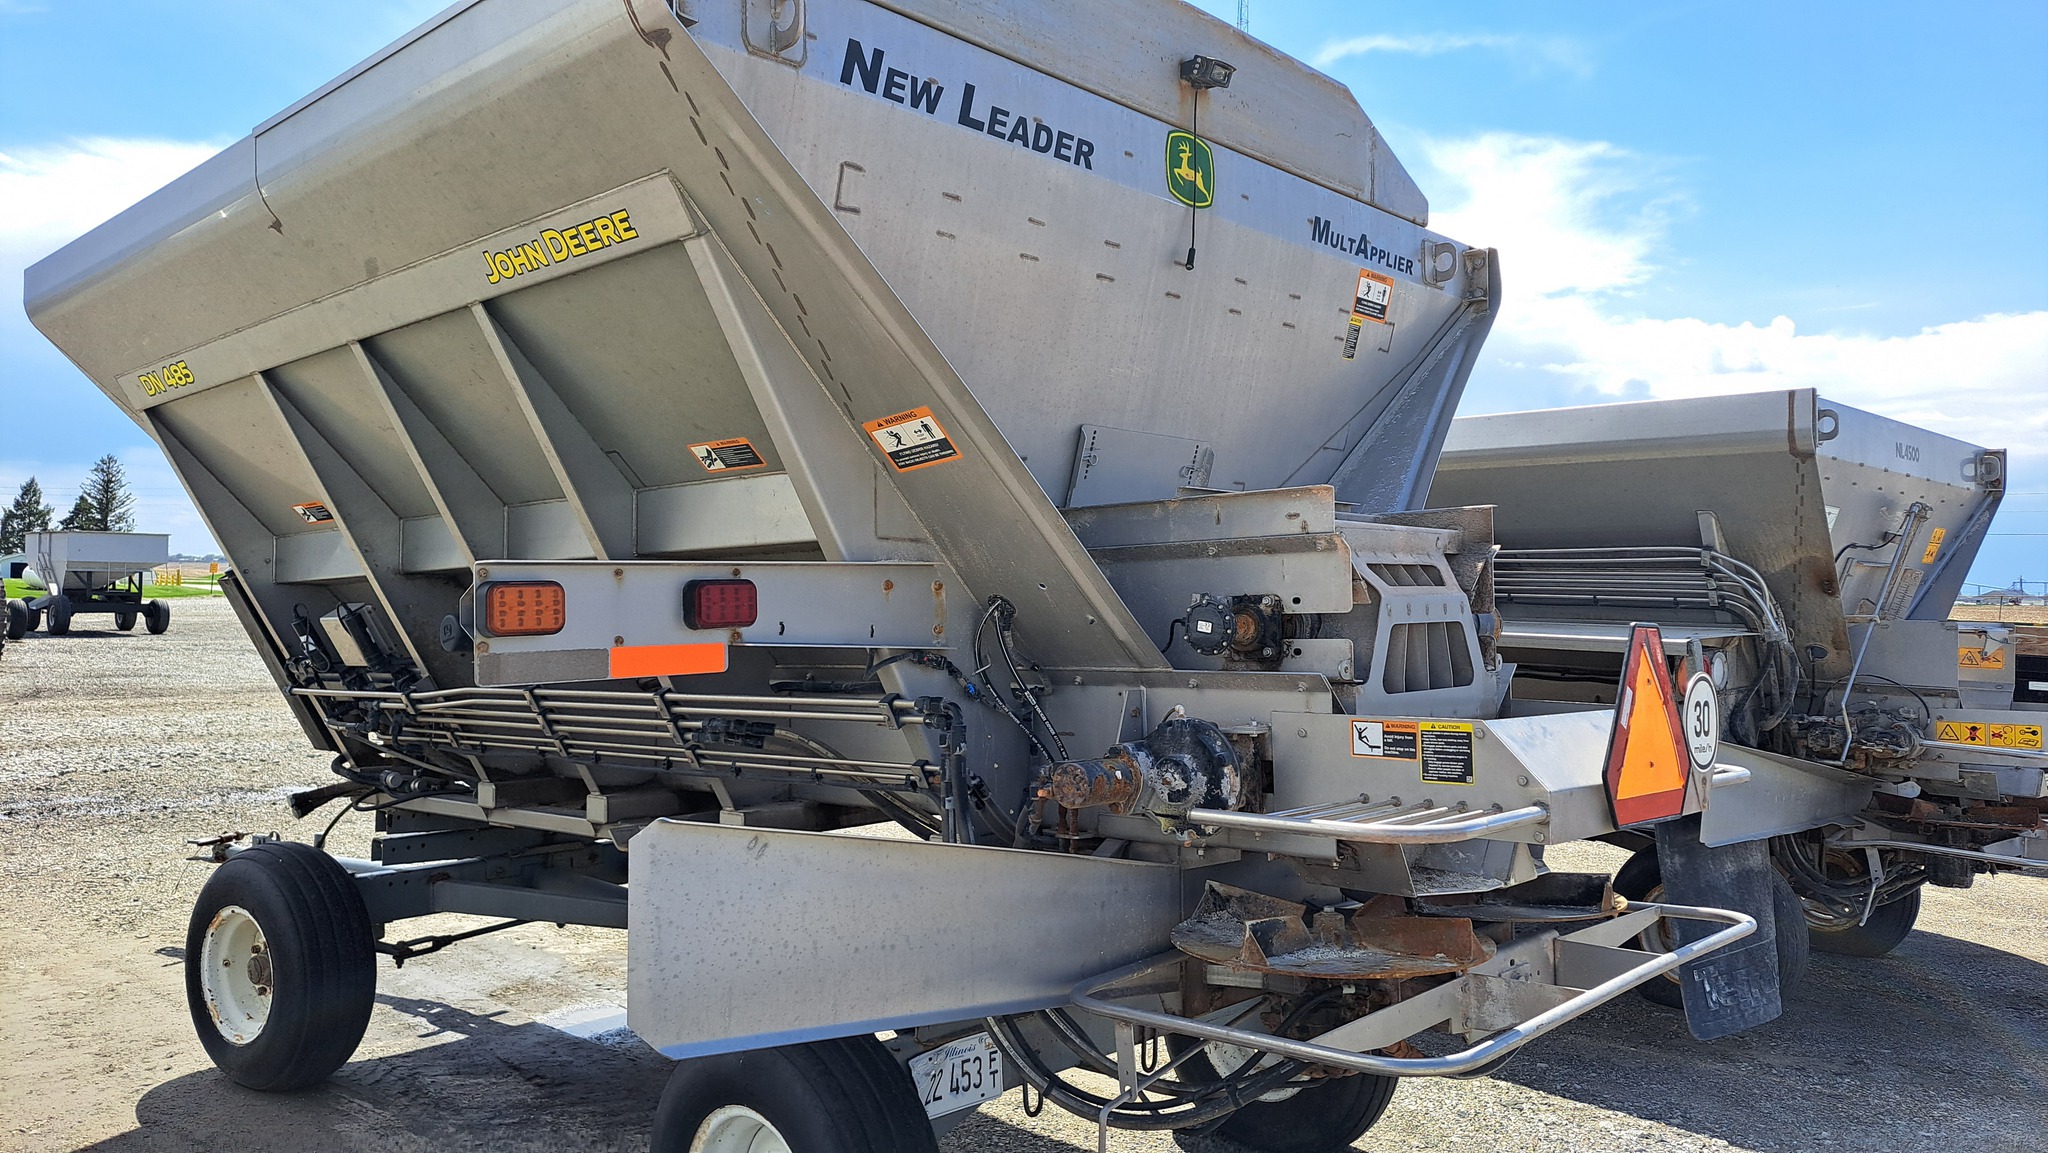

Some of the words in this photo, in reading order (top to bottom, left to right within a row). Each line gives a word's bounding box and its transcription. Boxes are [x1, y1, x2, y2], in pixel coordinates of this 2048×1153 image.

[839, 37, 945, 115] NEW
[957, 82, 1095, 171] LEADER
[485, 241, 548, 284] JOHN
[540, 209, 638, 263] DEERE
[139, 371, 165, 398] DN
[163, 360, 195, 389] 485
[883, 411, 918, 425] WARNING
[1895, 442, 1920, 463] NL4500
[1694, 700, 1710, 738] 30
[1693, 743, 1712, 754] mile/h
[943, 1044, 977, 1060] Illinois
[950, 1056, 982, 1095] 453
